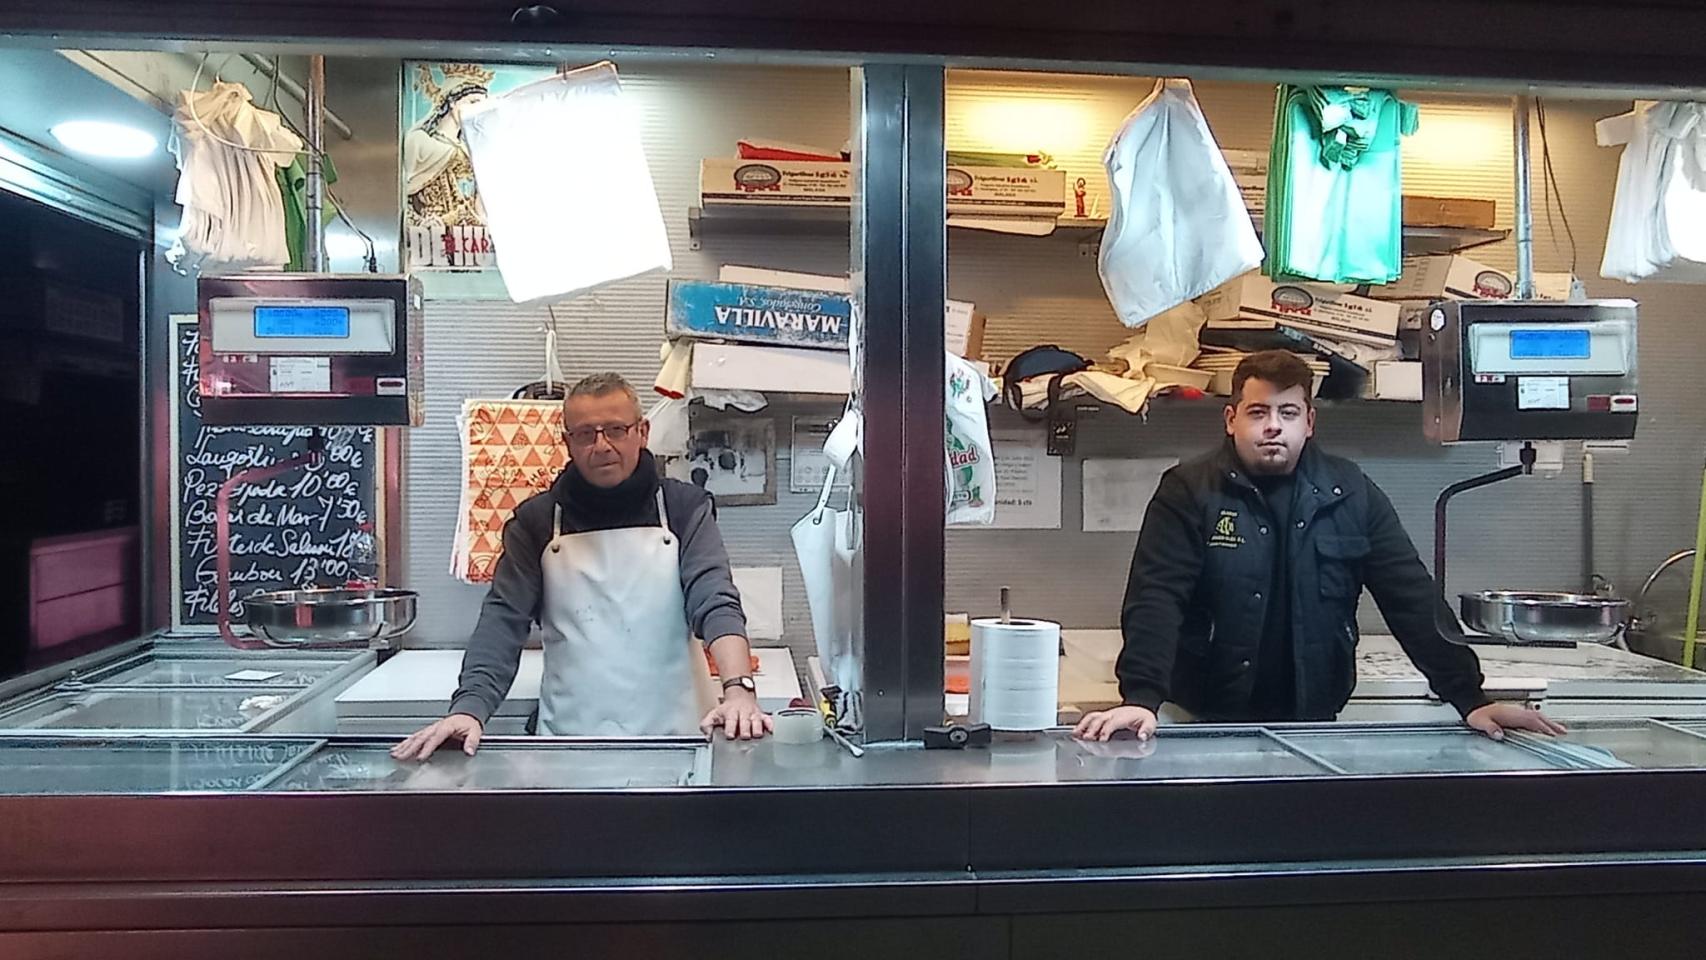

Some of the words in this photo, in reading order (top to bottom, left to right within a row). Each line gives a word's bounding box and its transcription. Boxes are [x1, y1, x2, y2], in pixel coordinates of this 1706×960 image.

[714, 306, 842, 334] MARAVILLA
[950, 445, 978, 466] dad
[187, 529, 253, 558] Fites
